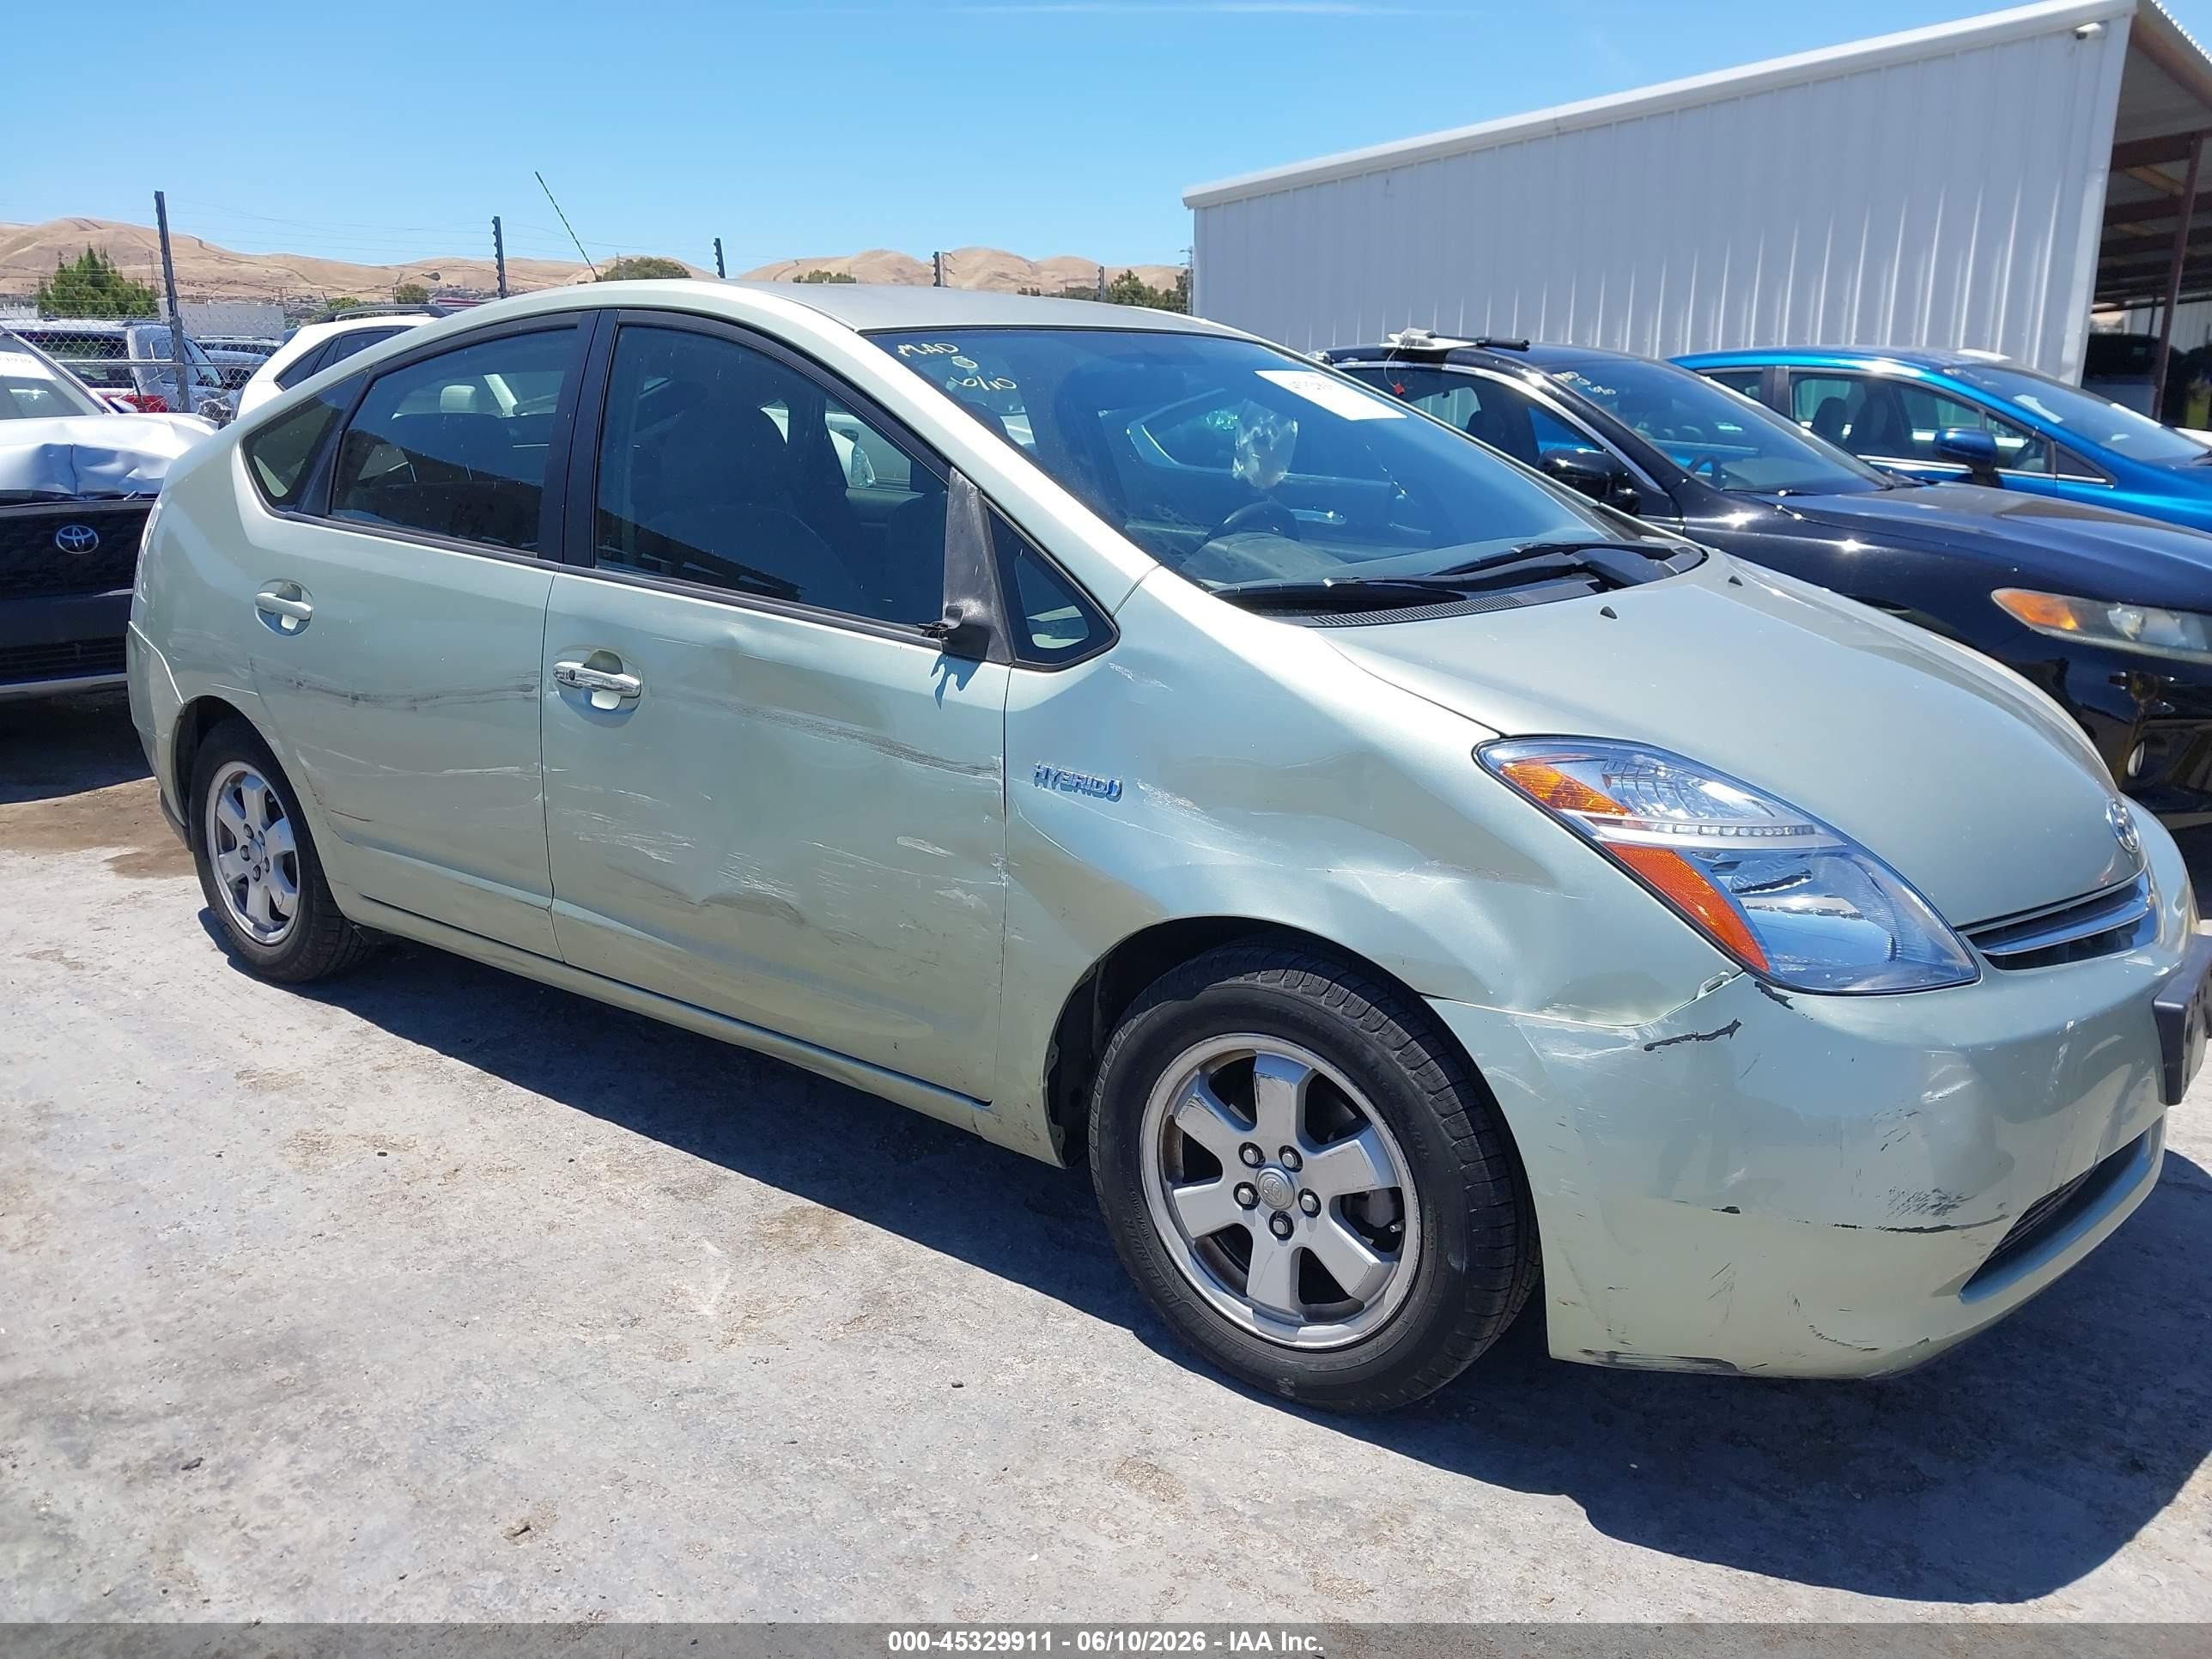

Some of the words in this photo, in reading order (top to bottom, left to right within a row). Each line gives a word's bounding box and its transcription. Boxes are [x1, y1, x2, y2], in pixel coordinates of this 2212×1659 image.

[897, 343, 959, 357] MAD
[950, 375, 1017, 391] 6/10
[1032, 763, 1109, 795] HYBRID
